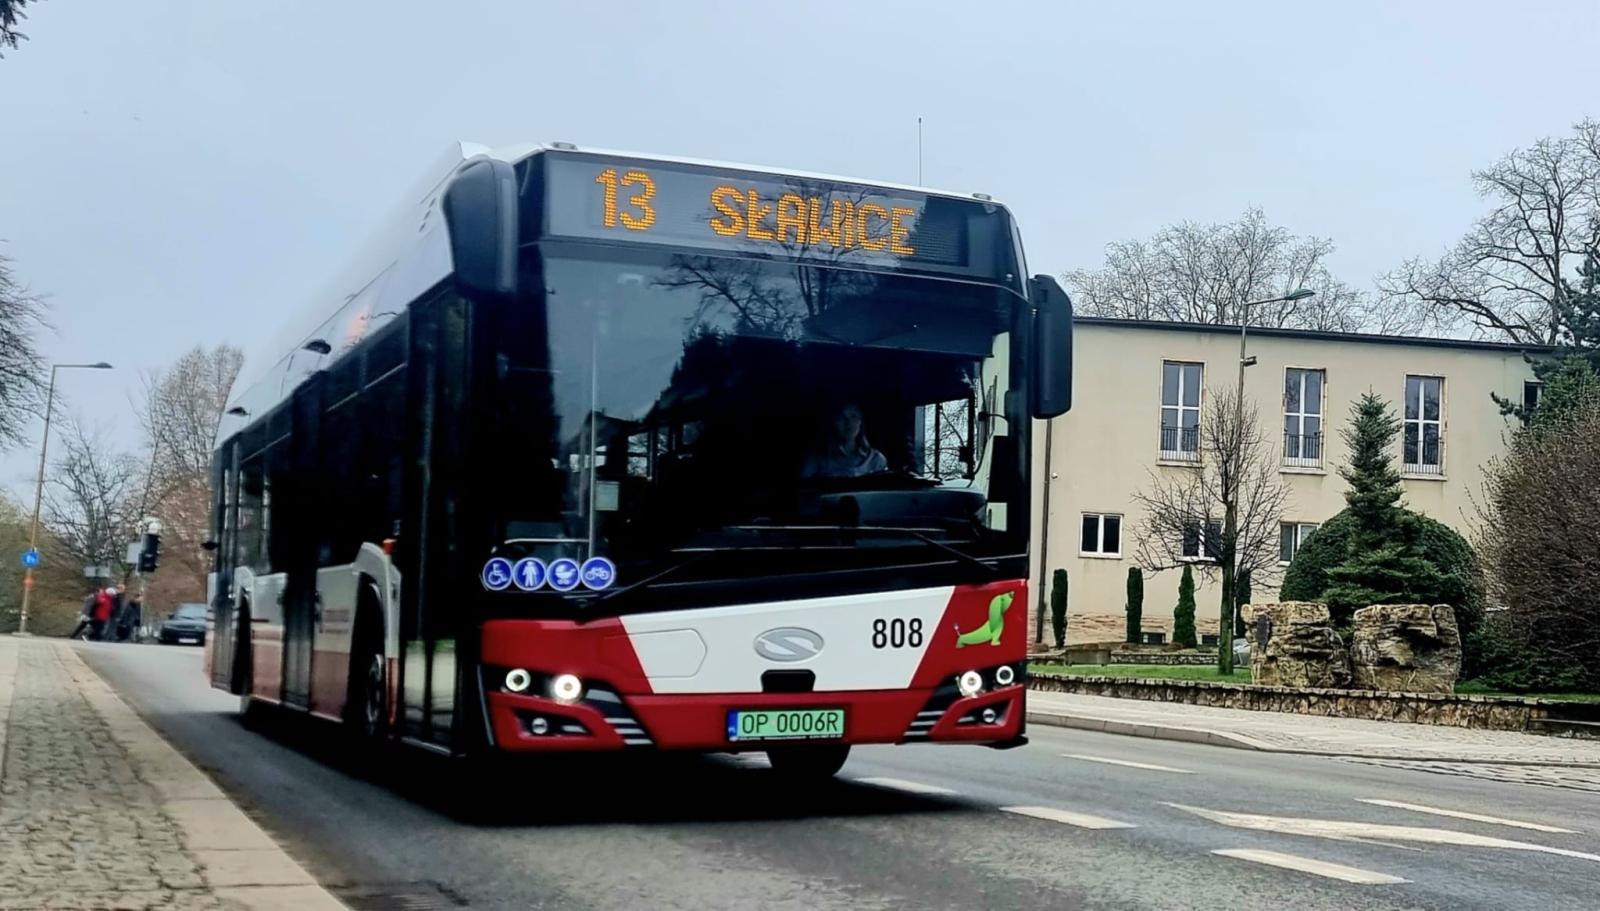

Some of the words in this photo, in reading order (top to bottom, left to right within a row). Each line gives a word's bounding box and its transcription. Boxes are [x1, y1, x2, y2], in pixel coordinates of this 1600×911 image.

[595, 168, 656, 230] 13
[710, 185, 915, 255] SŁAWICE
[872, 618, 923, 648] 808
[742, 714, 768, 734] OP
[777, 712, 839, 733] 0006R
